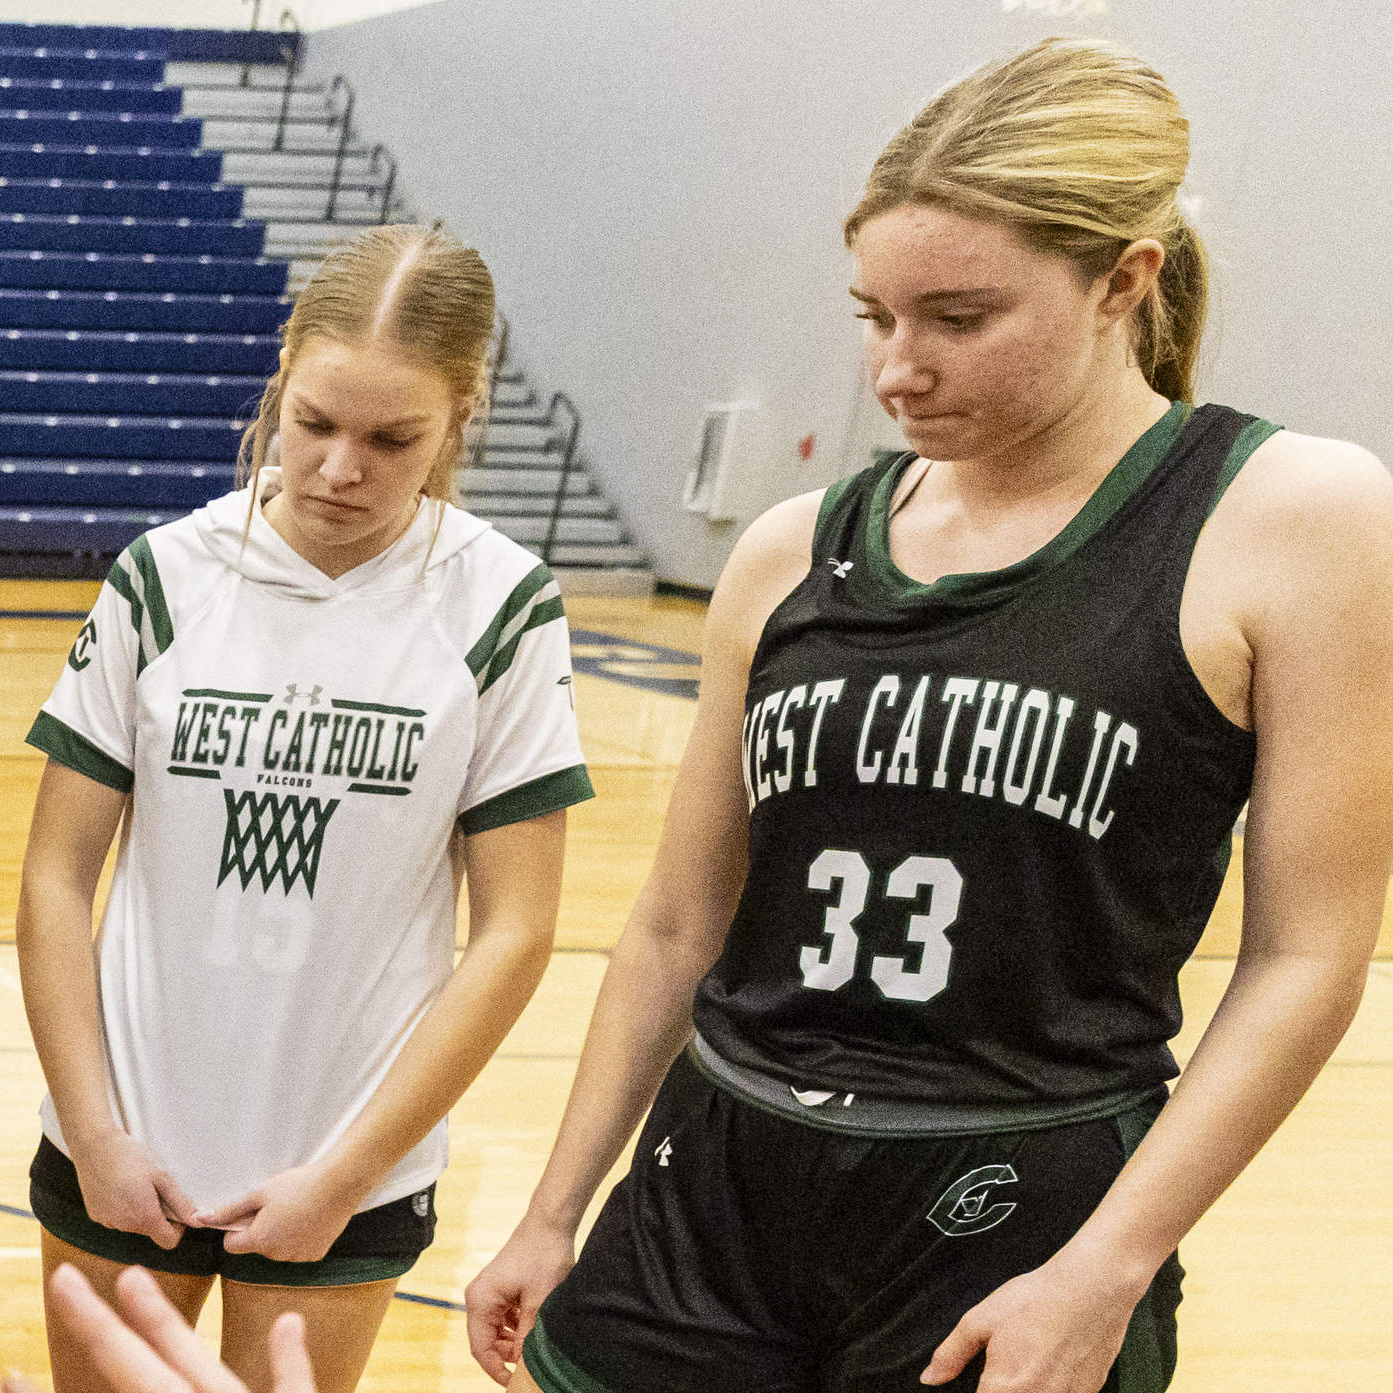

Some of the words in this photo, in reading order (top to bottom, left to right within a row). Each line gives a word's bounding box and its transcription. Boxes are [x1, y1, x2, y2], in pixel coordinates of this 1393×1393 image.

[170, 702, 262, 768] WEST
[263, 709, 425, 783] CATHOLIC
[256, 773, 312, 788] FALCONS
[856, 675, 1139, 839] CATHOLIC
[799, 848, 964, 1002] 33
